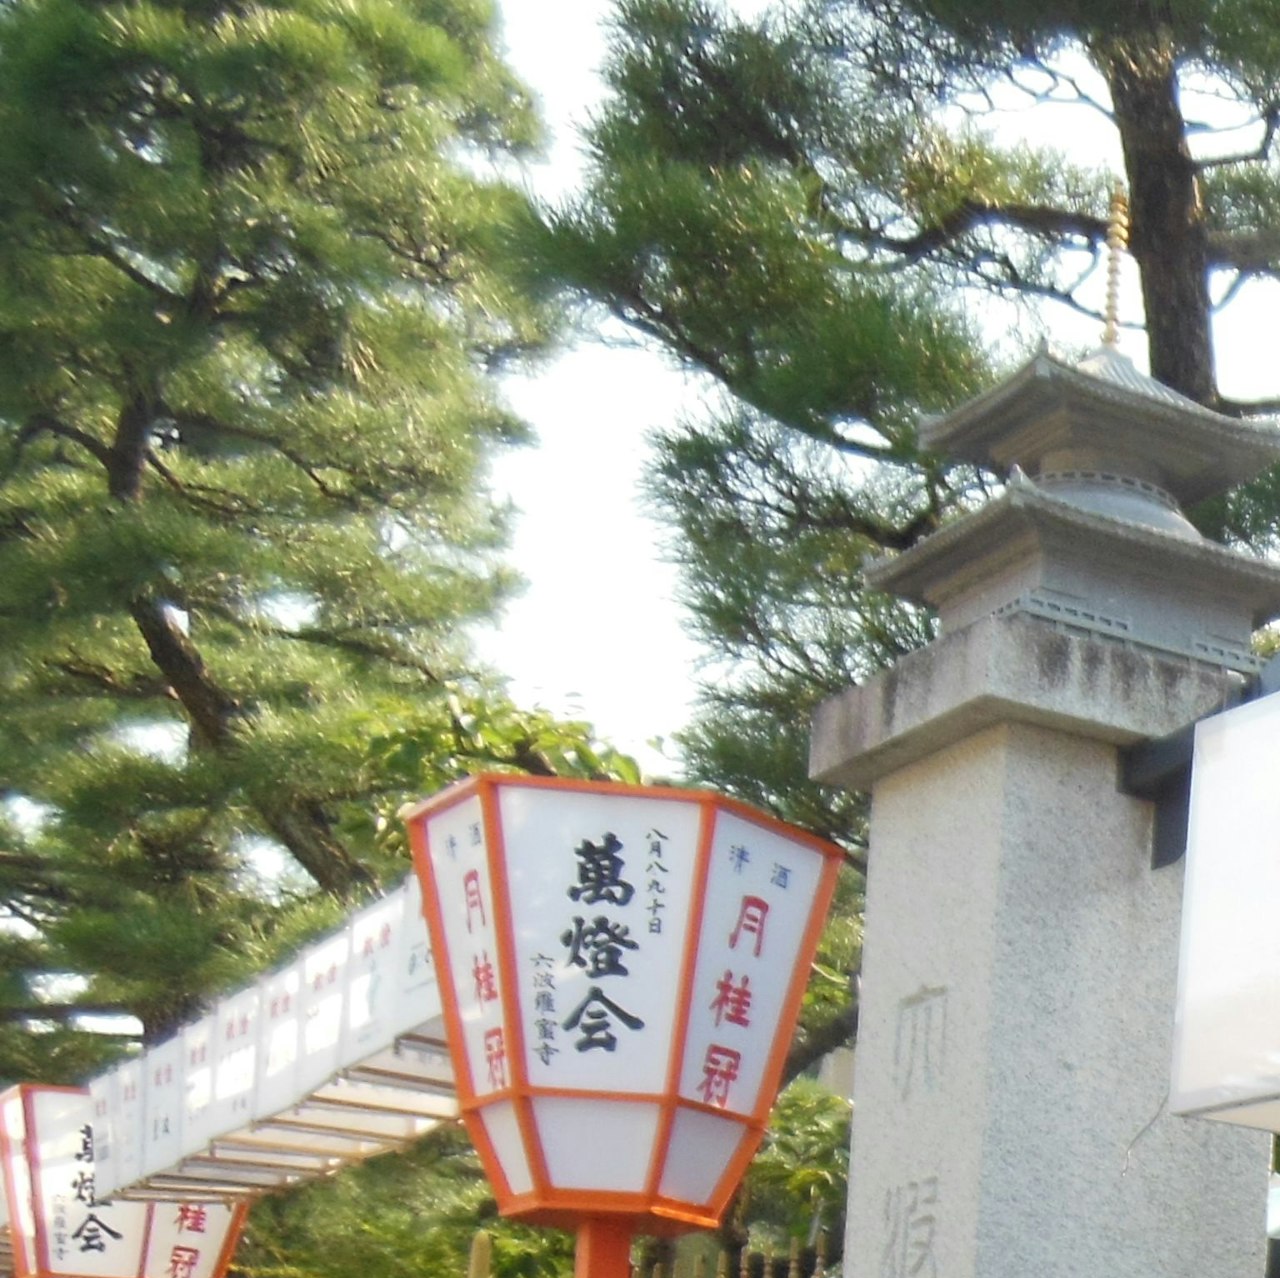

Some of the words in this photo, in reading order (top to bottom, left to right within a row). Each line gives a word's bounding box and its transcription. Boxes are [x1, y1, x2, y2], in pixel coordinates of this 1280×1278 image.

[560, 831, 646, 1053] 萬燈会
[728, 844, 792, 890] 清酒
[462, 868, 509, 1092] 月桂冠
[696, 894, 770, 1110] 月桂冠
